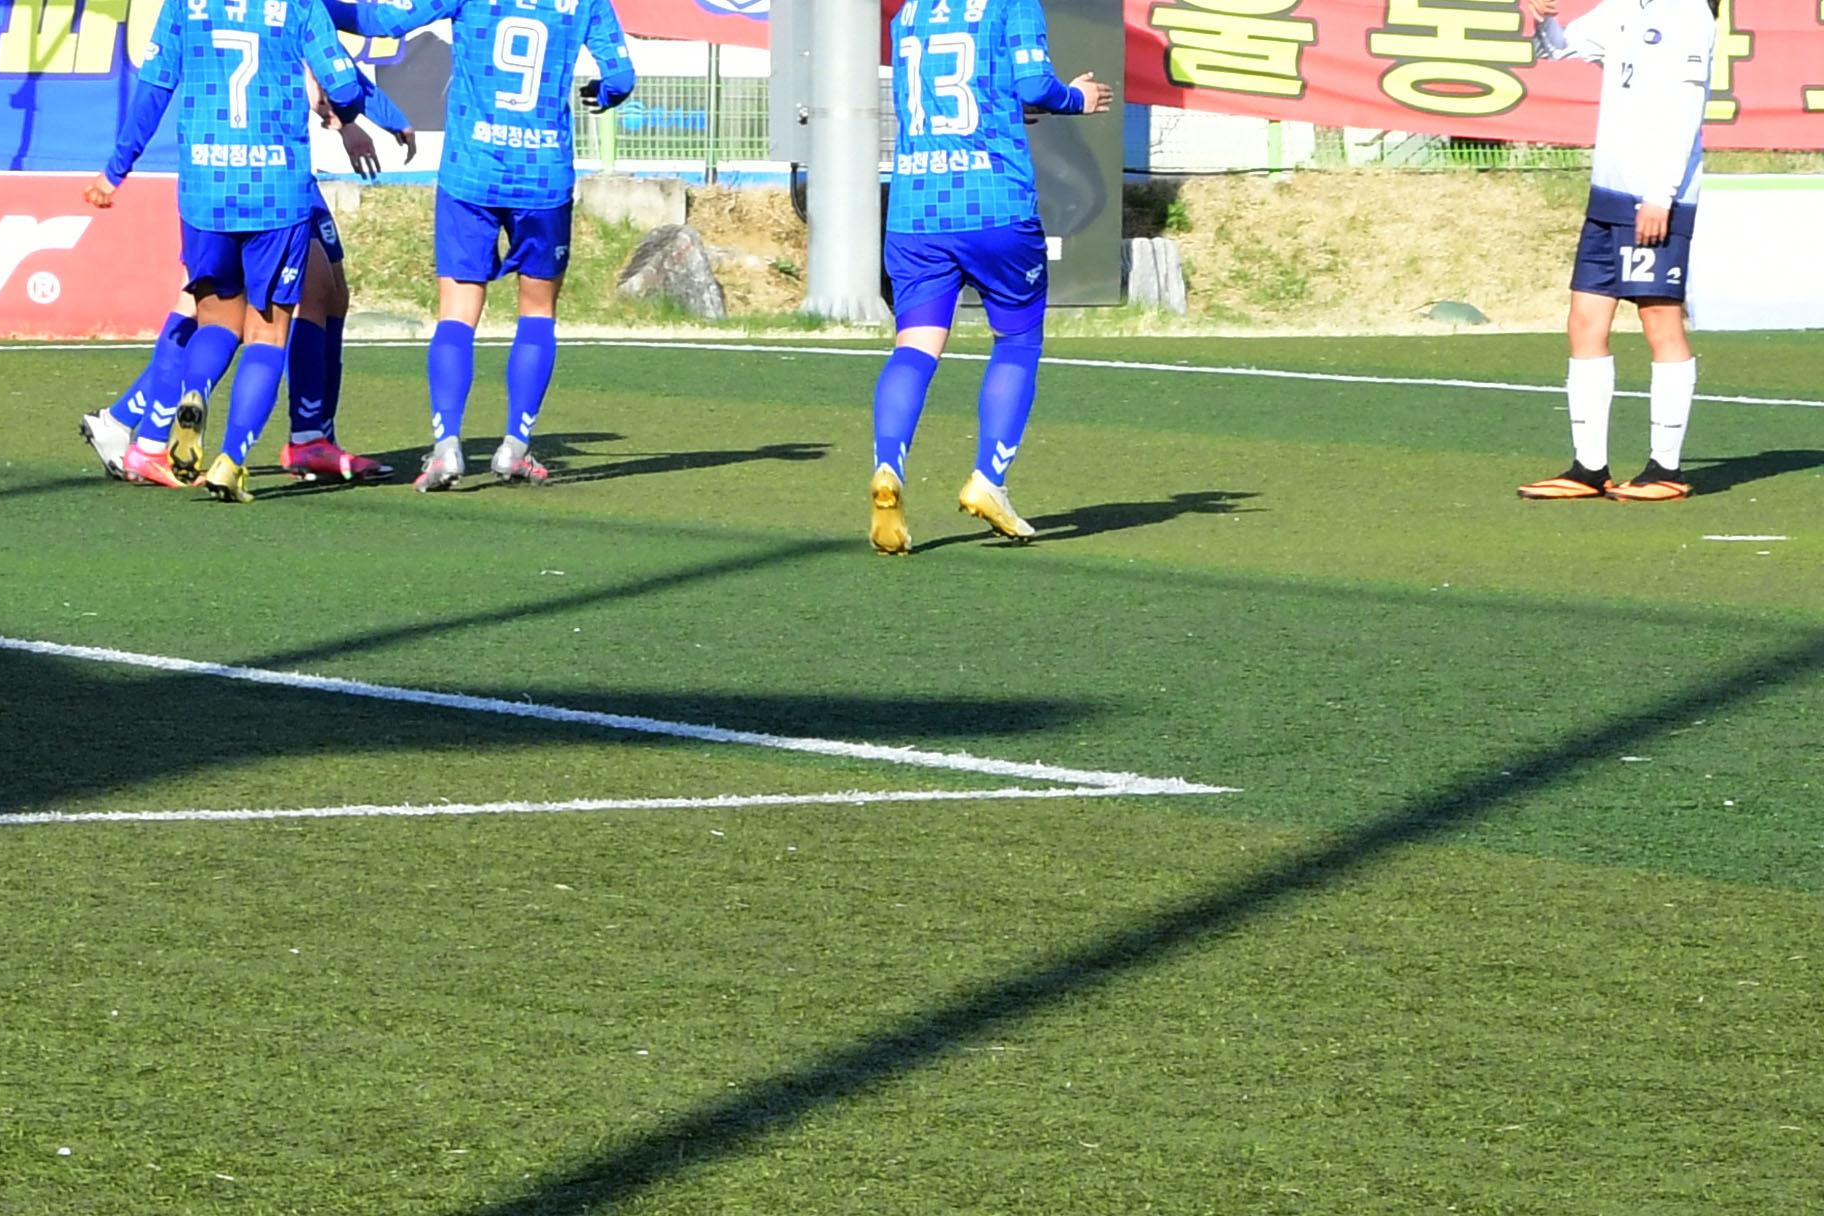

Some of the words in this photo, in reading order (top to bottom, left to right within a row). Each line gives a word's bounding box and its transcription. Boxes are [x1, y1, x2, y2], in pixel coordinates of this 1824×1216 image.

[211, 29, 260, 129] 7
[492, 15, 549, 112] 9
[898, 30, 980, 137] 13
[190, 143, 288, 168] 화천정산고
[1619, 245, 1657, 283] 12
